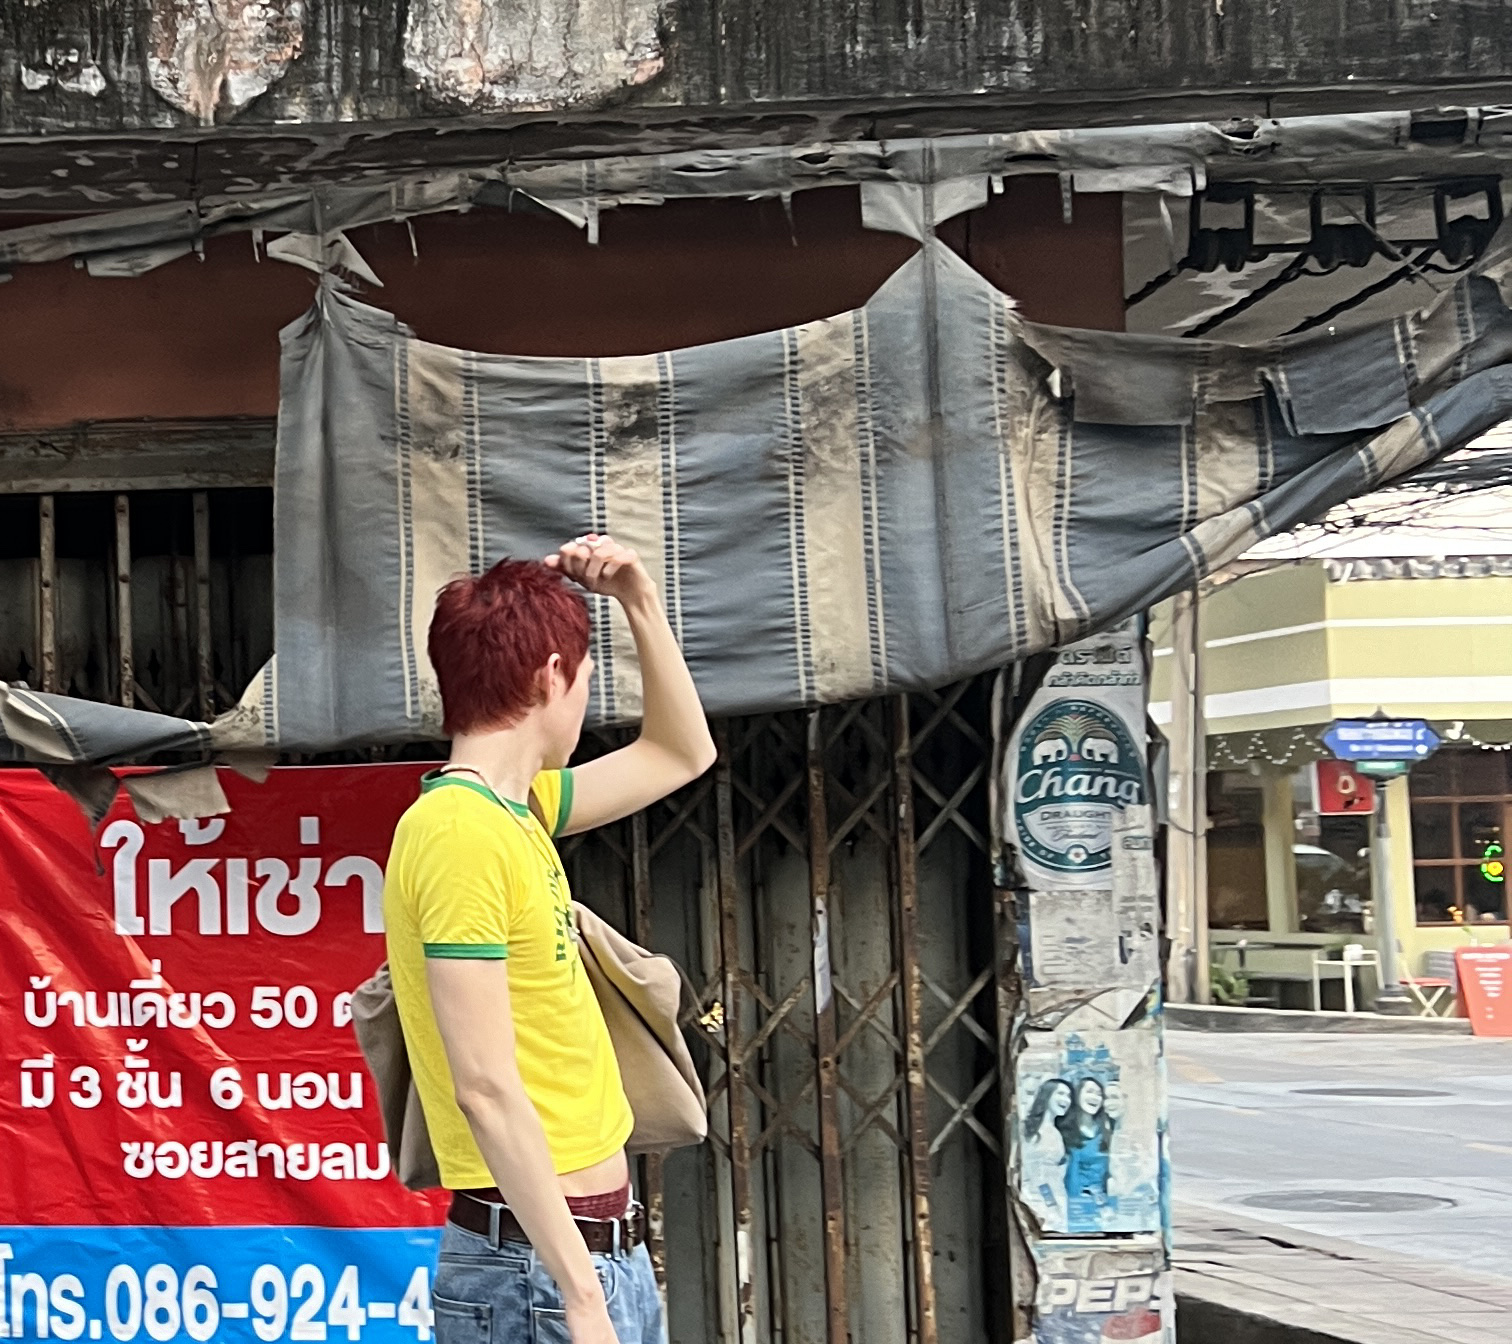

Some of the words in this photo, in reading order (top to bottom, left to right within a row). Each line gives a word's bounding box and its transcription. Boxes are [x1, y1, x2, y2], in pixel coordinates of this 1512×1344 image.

[1015, 767, 1141, 806] Chang
[100, 813, 386, 936] ให้เช่า
[24, 959, 236, 1029] บ้านเดี่ยว
[250, 985, 318, 1029] 50
[21, 1053, 55, 1108] มี
[69, 1066, 102, 1109] 3
[116, 1039, 183, 1109] ชั้น
[210, 1066, 245, 1110] 6
[257, 1071, 363, 1110] นอน
[120, 1139, 391, 1181] ซอยสายลม
